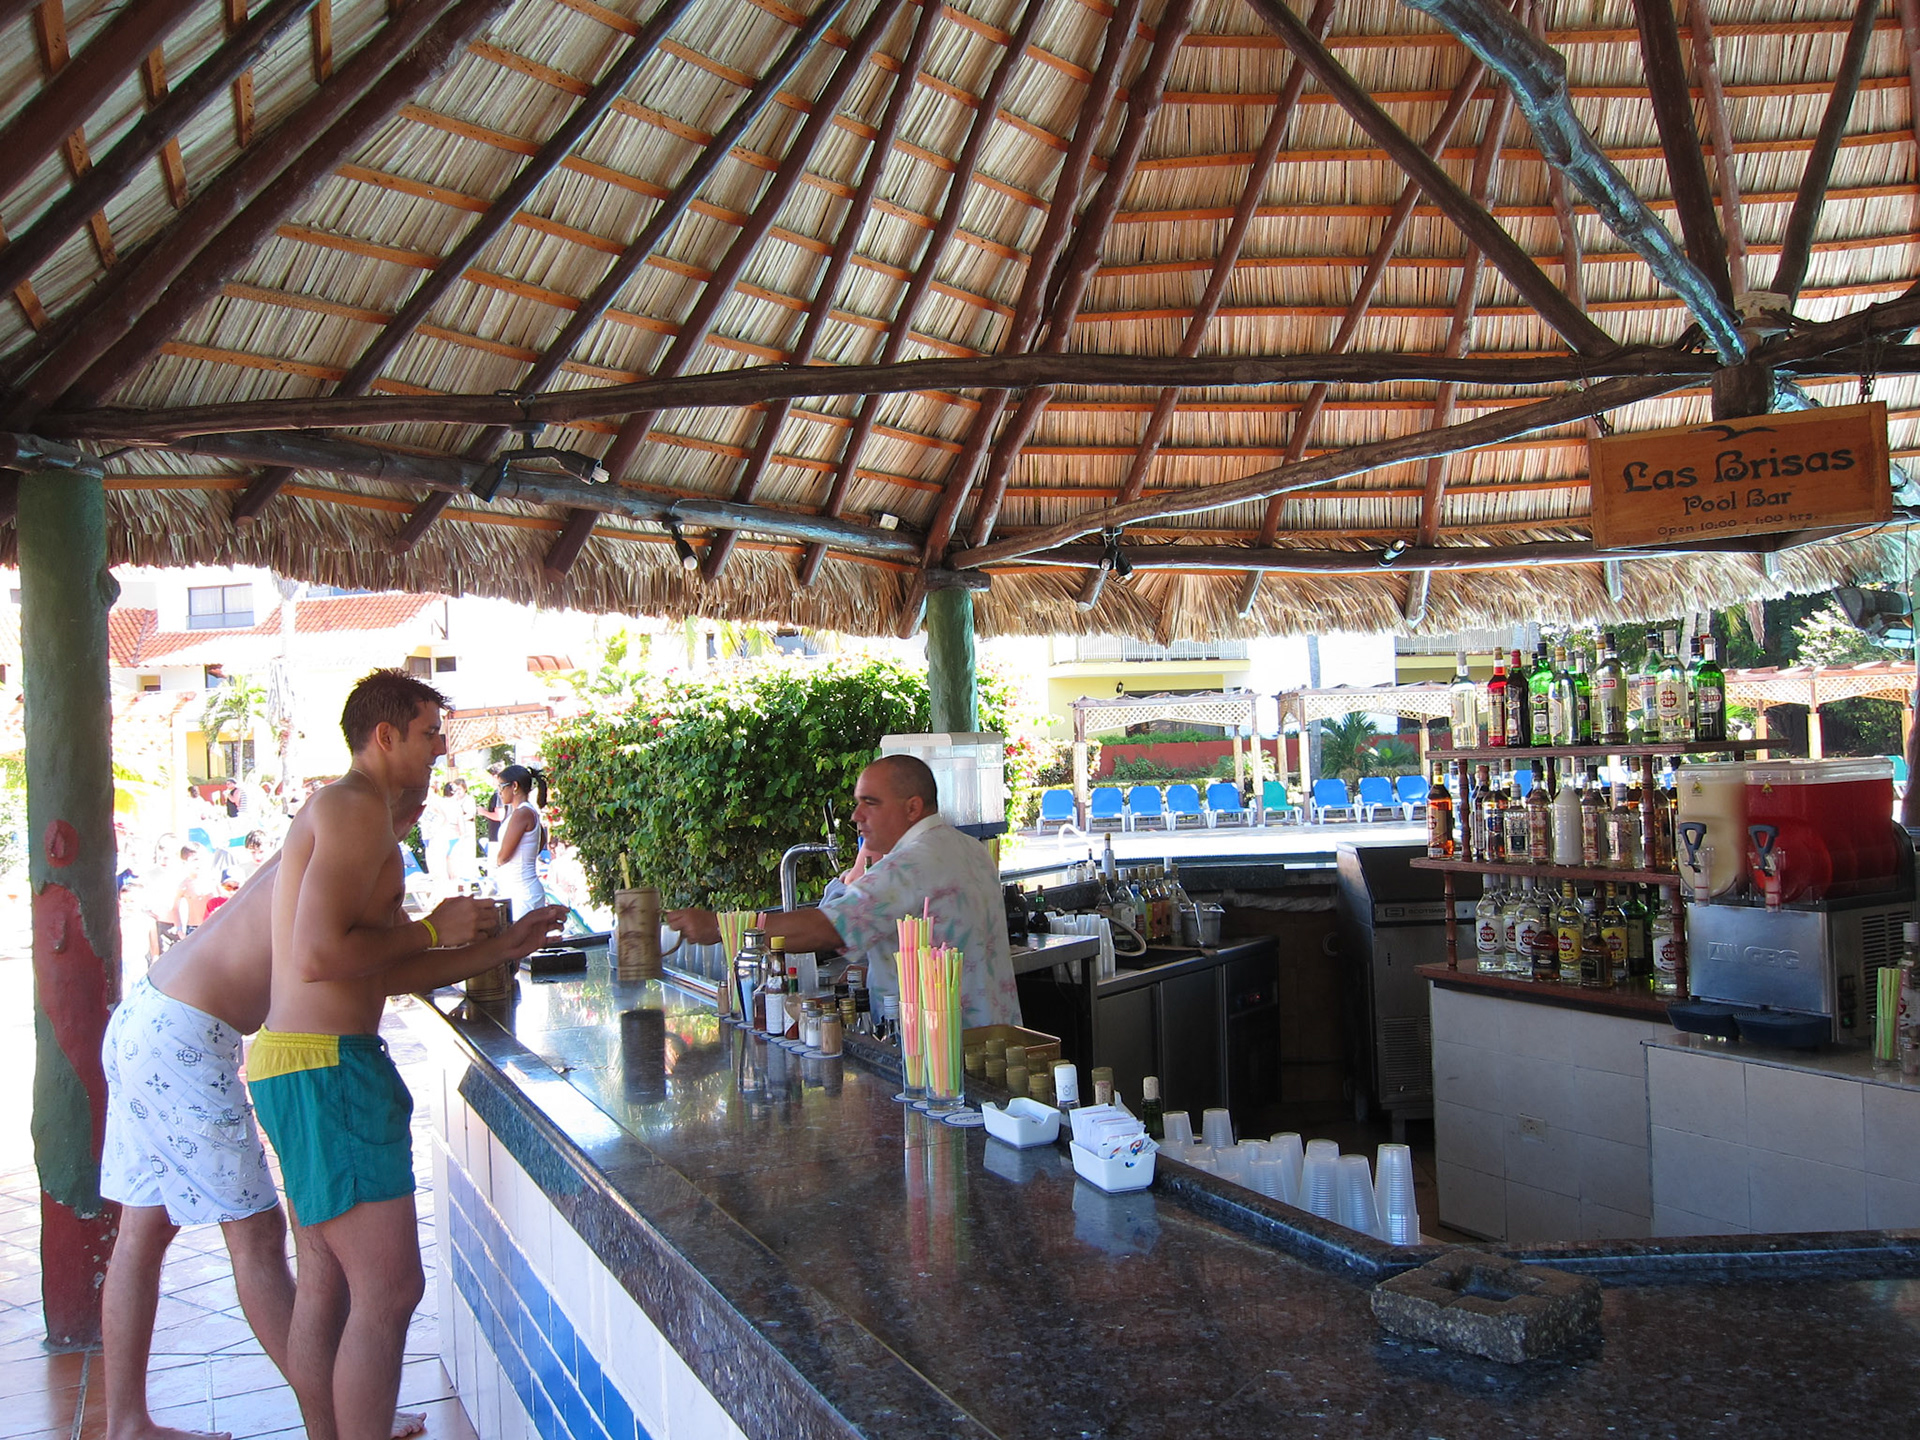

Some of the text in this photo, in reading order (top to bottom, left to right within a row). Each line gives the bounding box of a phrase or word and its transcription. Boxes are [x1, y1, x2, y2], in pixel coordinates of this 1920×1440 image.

[1622, 448, 1855, 493] Las Brisas
[1682, 488, 1792, 516] Pool Bar
[1657, 524, 1695, 537] Open
[1700, 519, 1737, 531] 10:00
[1755, 514, 1783, 525] 1:00
